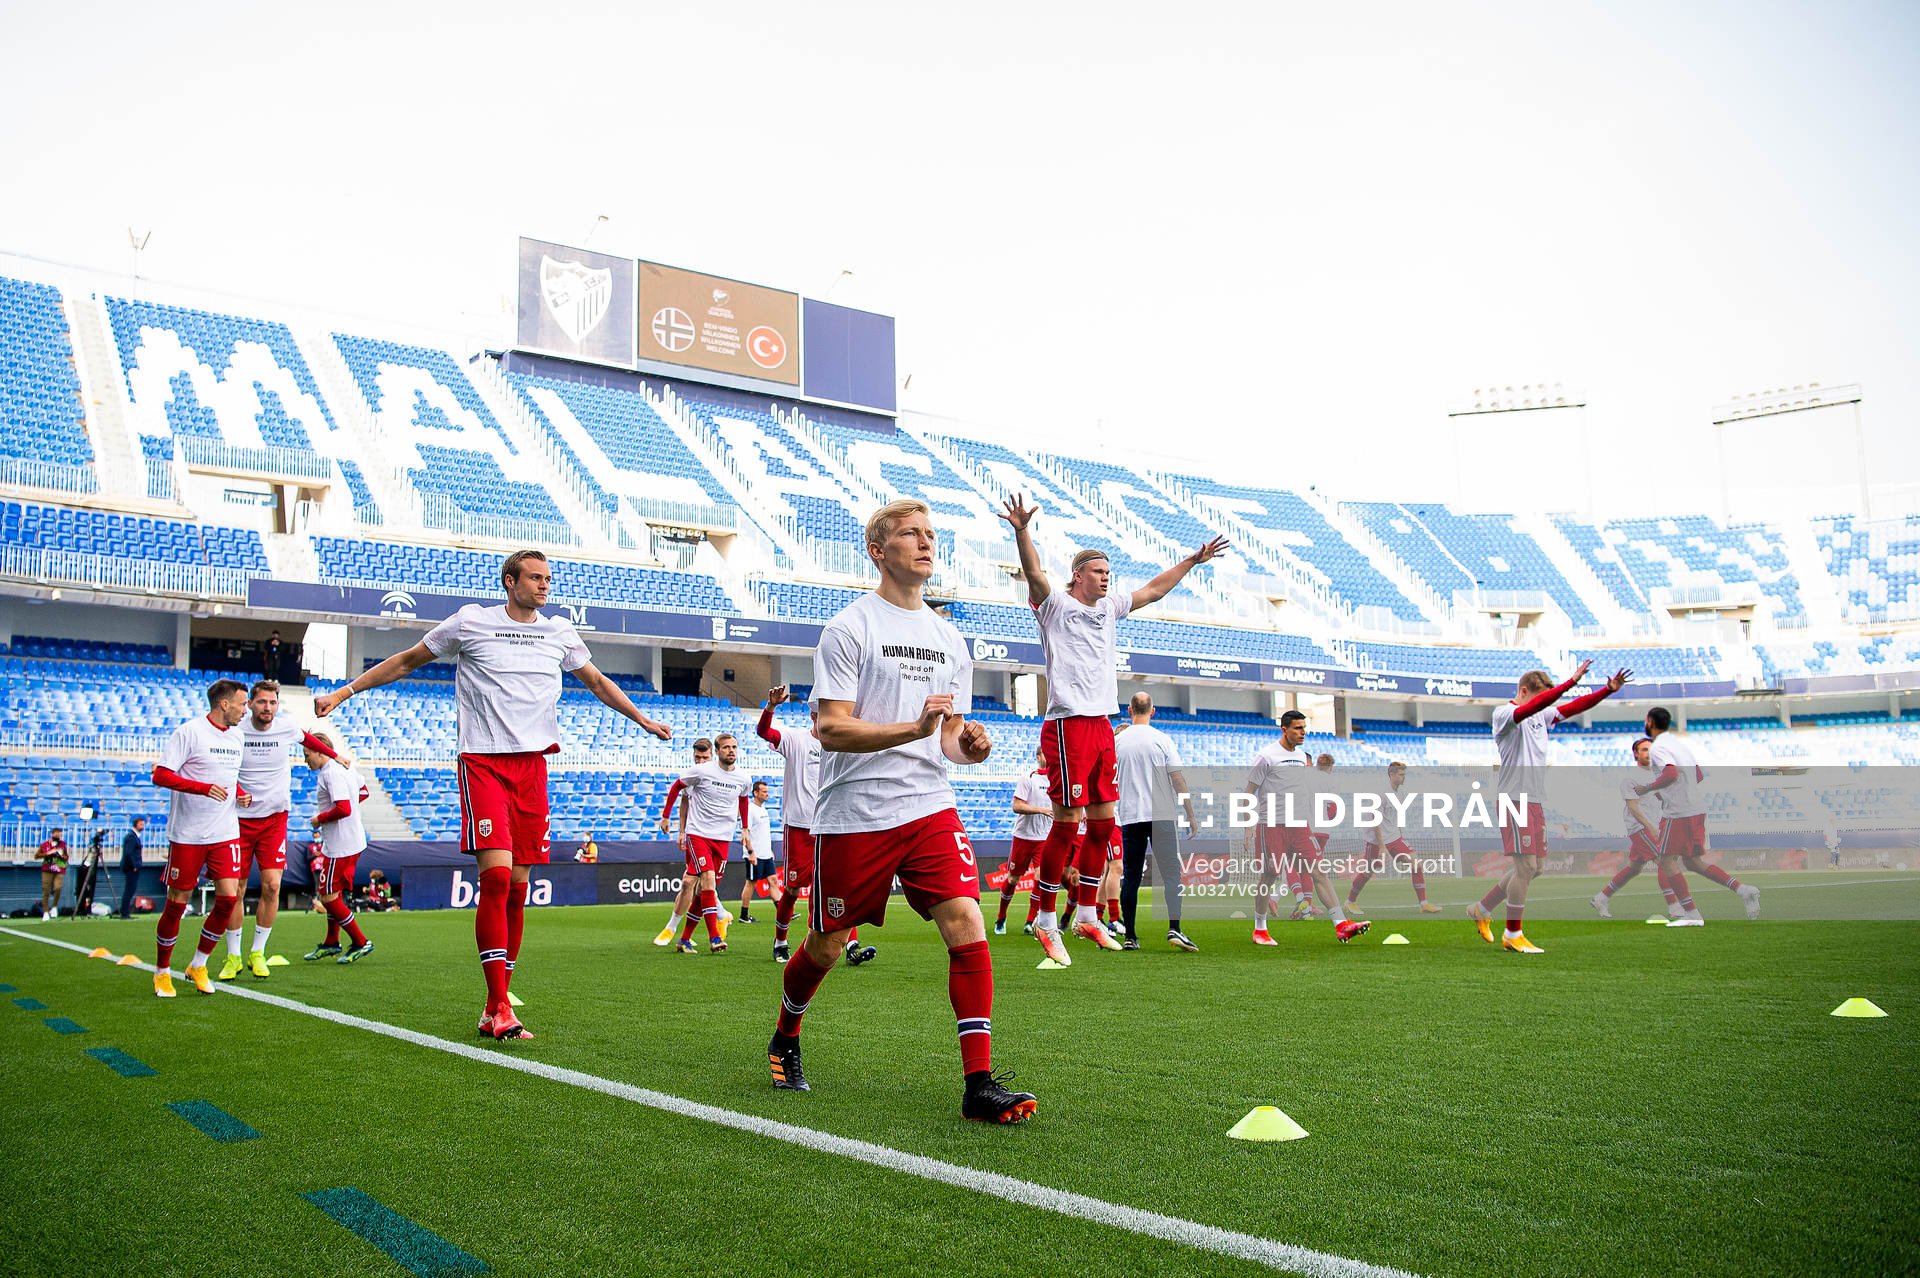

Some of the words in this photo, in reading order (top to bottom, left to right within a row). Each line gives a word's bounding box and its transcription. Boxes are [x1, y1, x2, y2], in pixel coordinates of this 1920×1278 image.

[882, 645, 915, 659] HUMAN
[916, 647, 945, 664] RIGHTS
[900, 662, 908, 670] On
[910, 664, 921, 672] and
[902, 672, 911, 680] the
[913, 674, 931, 683] pitch
[278, 839, 286, 855] 4
[953, 832, 974, 866] 5
[451, 870, 552, 908] ba
[618, 874, 682, 897] equino
